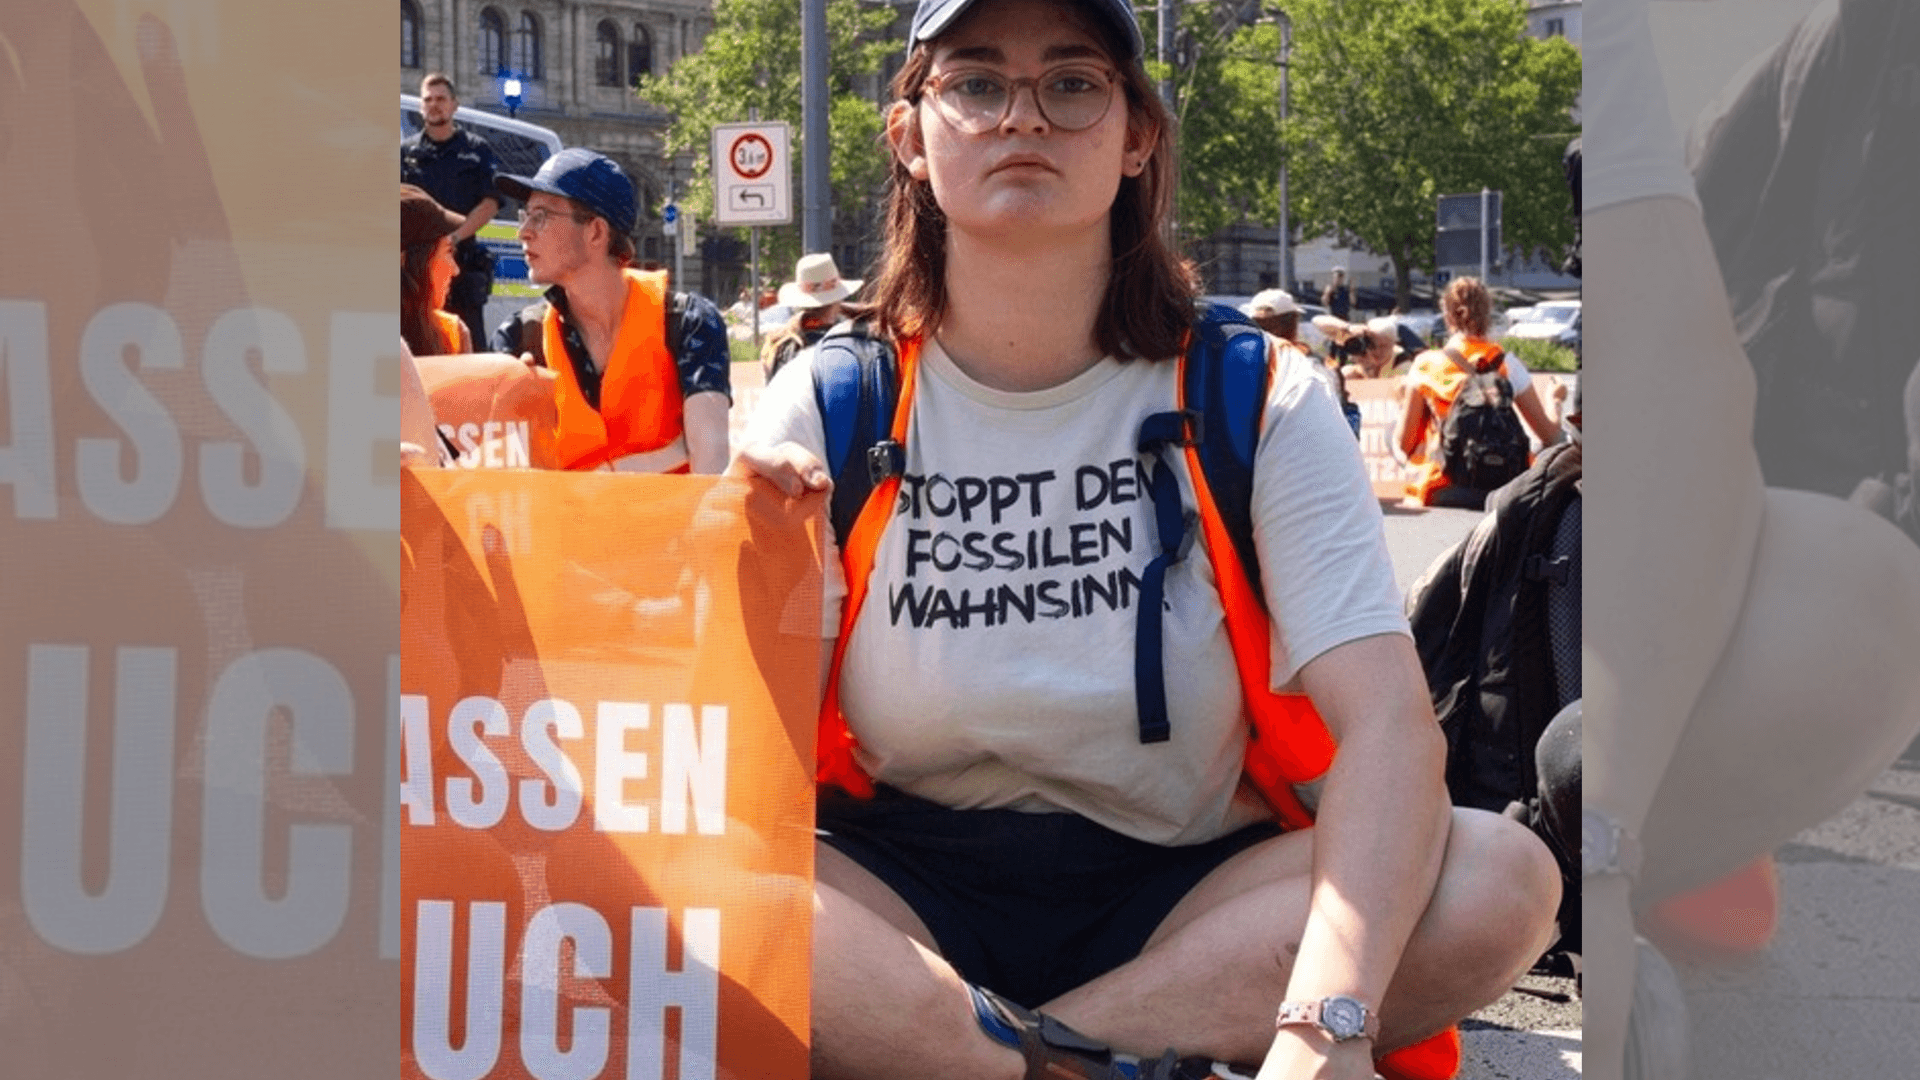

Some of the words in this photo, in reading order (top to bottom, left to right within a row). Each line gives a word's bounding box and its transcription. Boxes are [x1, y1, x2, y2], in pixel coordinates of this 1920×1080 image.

[906, 516, 1132, 577] FOSSILEN
[20, 643, 401, 962] UC
[412, 898, 721, 1080] UCH
